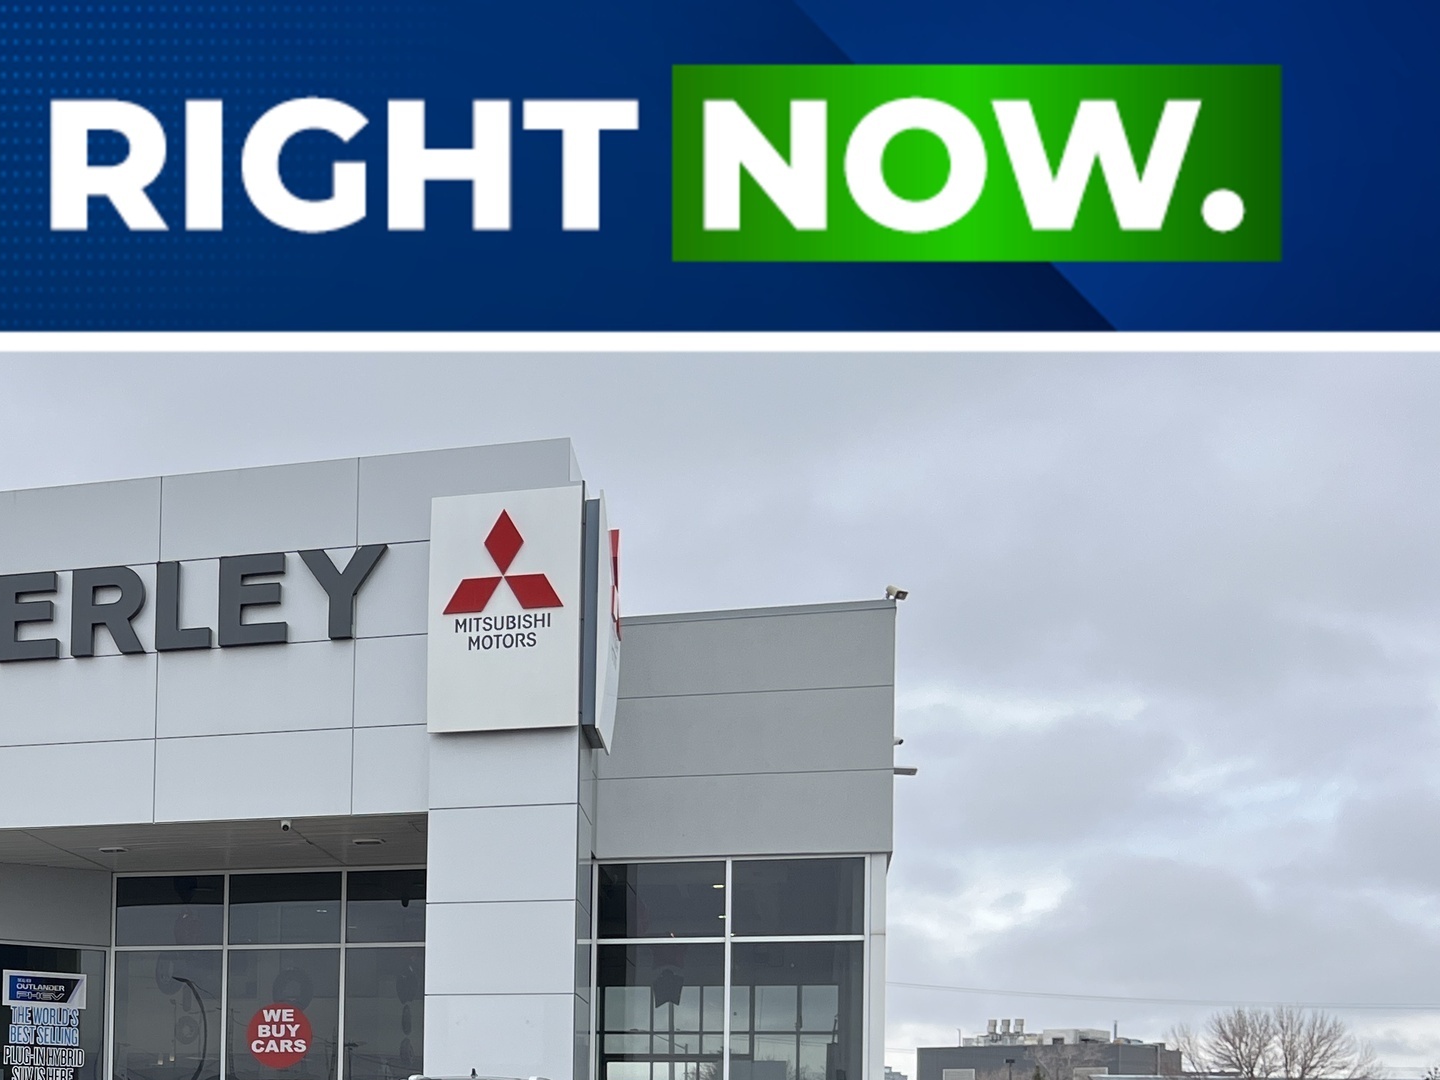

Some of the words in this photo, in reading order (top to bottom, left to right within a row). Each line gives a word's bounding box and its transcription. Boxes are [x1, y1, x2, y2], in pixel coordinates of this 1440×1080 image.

[455, 612, 551, 633] MITSUBISHI
[468, 632, 537, 651] MOTORS
[16, 983, 65, 992] OUTLANDER
[11, 1006, 32, 1024] THE
[32, 1006, 79, 1026] WORLD'S
[263, 1009, 295, 1022] WE
[9, 1024, 36, 1044] BEST
[37, 1025, 79, 1046] SELLING
[258, 1024, 301, 1038] BUY
[251, 1039, 307, 1053] CARS
[3, 1045, 45, 1066] PLUG-IN
[46, 1047, 85, 1067] HYBRID
